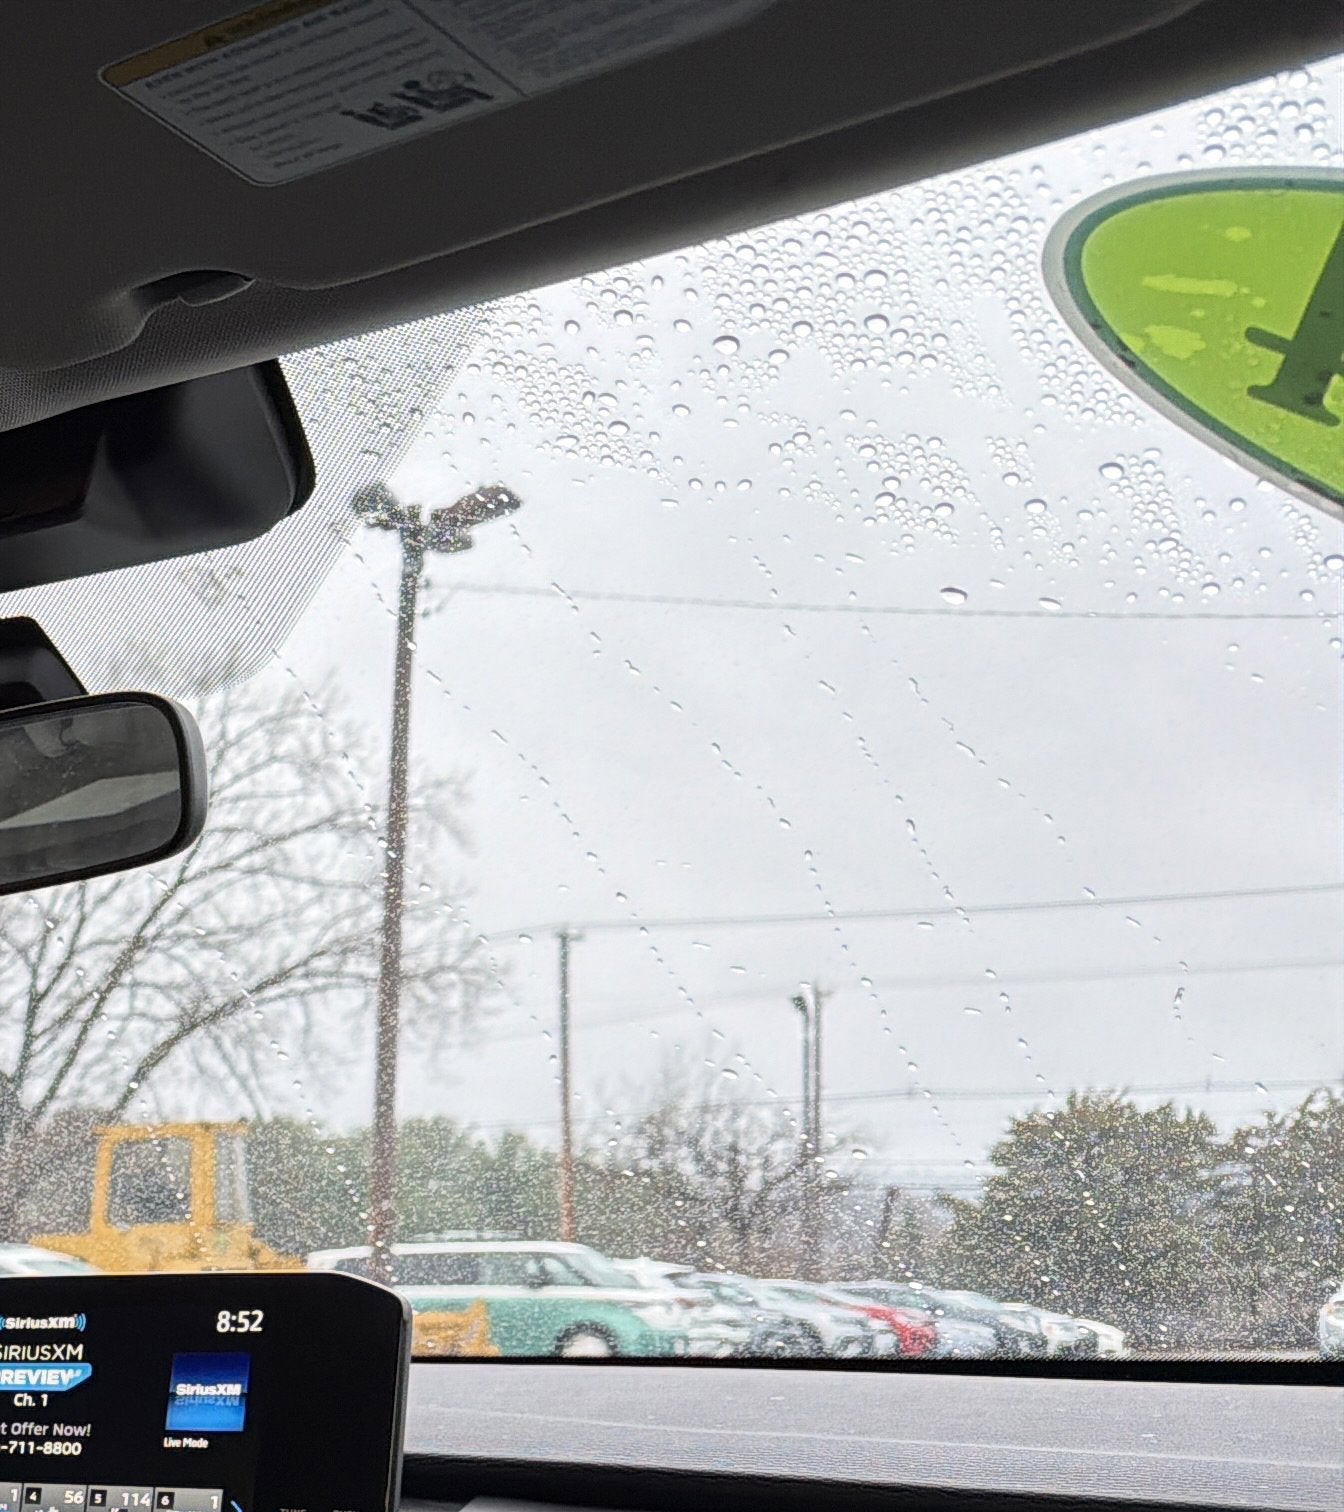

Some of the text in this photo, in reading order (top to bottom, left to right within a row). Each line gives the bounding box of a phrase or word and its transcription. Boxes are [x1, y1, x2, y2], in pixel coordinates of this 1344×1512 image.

[216, 1310, 263, 1333] 8:52
[13, 1394, 48, 1407] Ch. 1
[11, 1421, 48, 1436] Offer
[53, 1422, 91, 1437] Now!
[163, 1437, 208, 1449] Live Mode
[10, 1488, 18, 1501] 1
[29, 1491, 37, 1501] 4
[64, 1490, 84, 1504] 56
[94, 1493, 102, 1503] 5
[122, 1492, 151, 1507] 114
[161, 1495, 170, 1505] 6
[210, 1495, 218, 1509] 1
